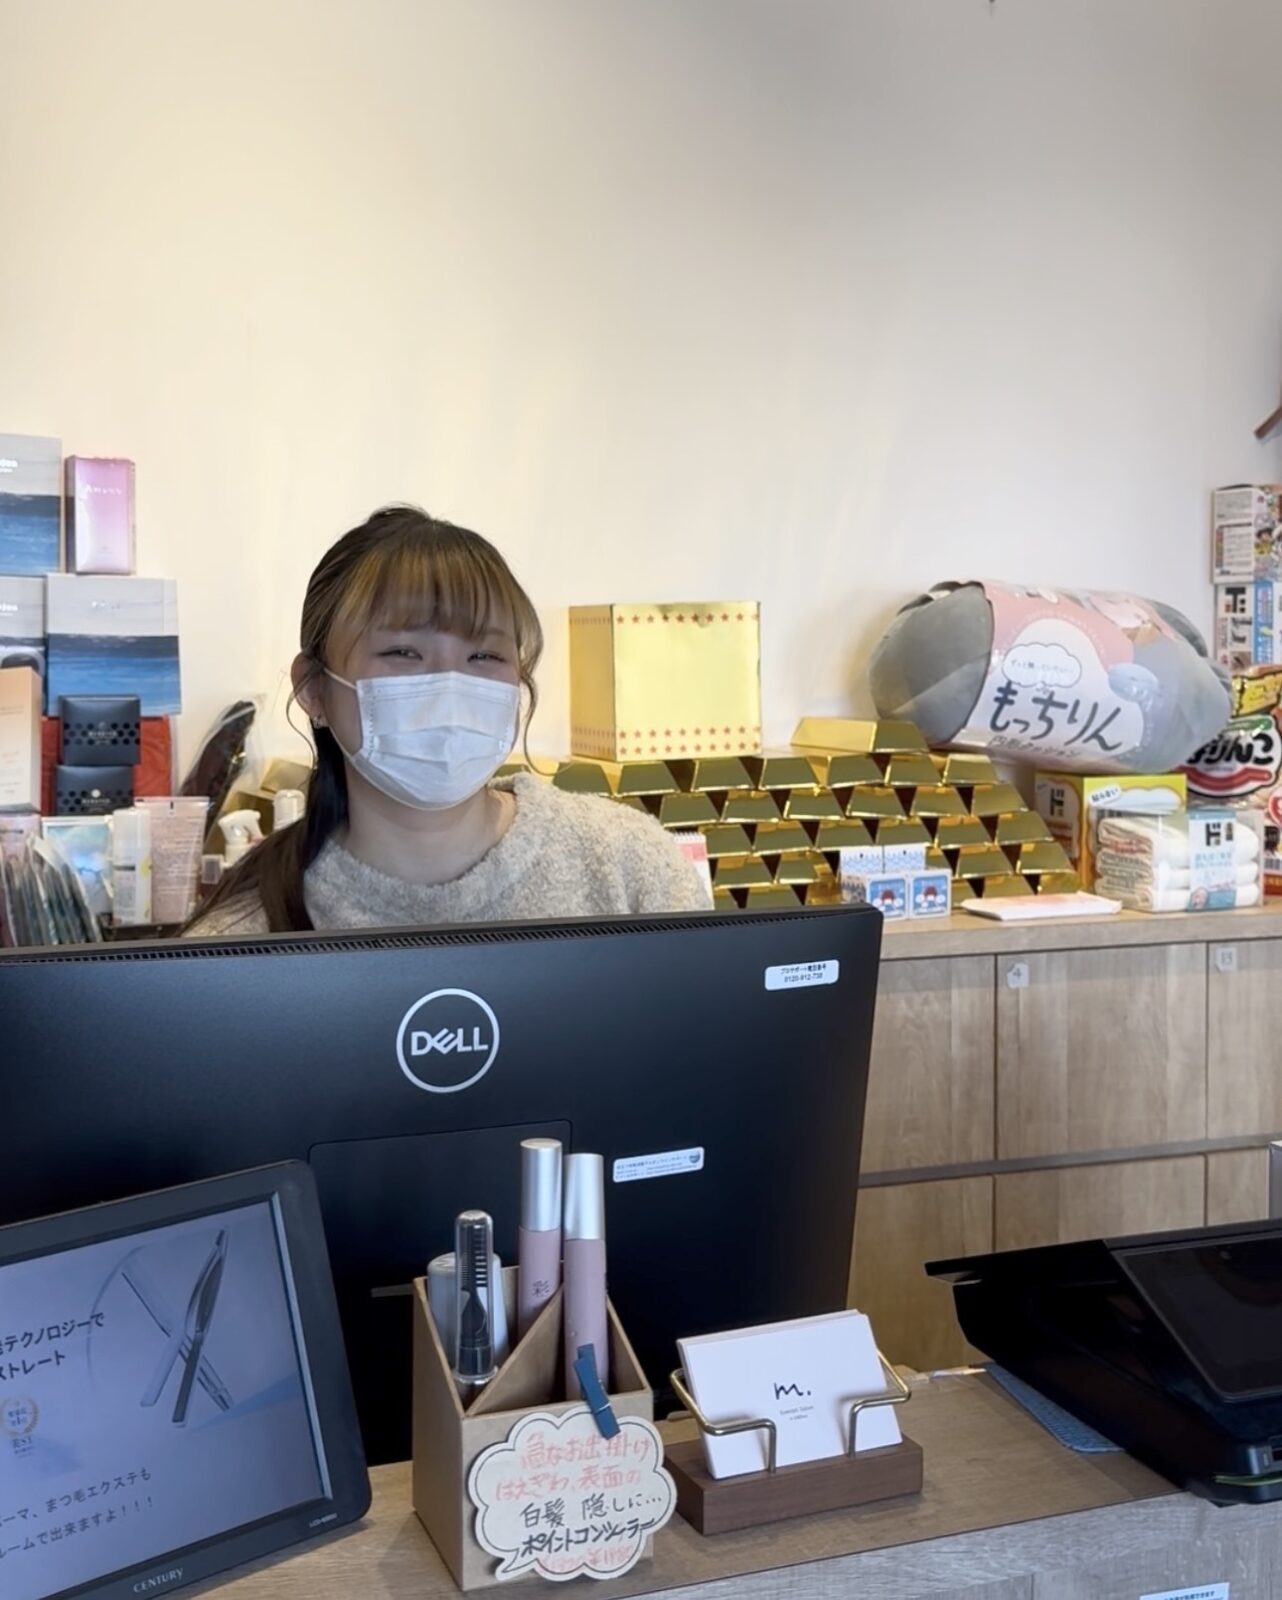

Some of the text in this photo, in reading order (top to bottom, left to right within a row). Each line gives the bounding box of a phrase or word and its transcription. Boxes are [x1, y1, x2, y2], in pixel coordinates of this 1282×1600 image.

[990, 680, 1122, 752] もっちりん
[411, 1027, 489, 1056] DELL
[0, 1312, 105, 1355] テクノロジーで
[0, 1467, 152, 1528] ーマ、まつ毛エクステも
[133, 1567, 184, 1594] CENTURY
